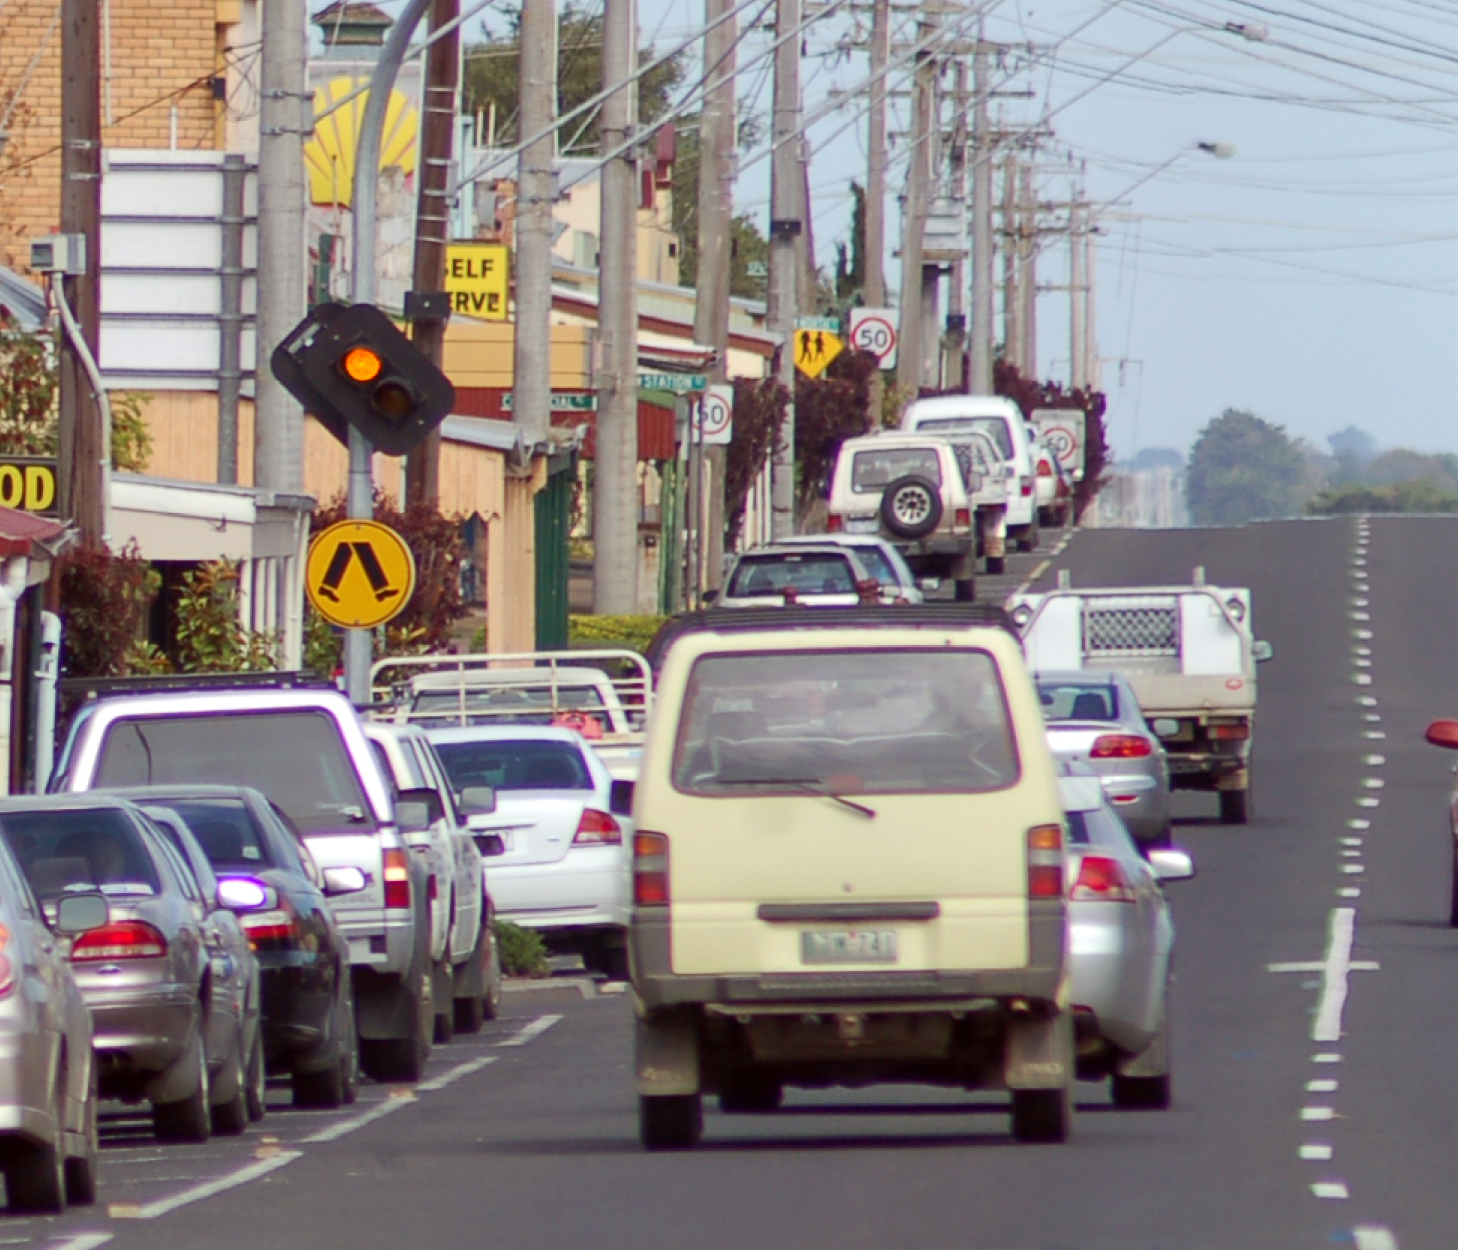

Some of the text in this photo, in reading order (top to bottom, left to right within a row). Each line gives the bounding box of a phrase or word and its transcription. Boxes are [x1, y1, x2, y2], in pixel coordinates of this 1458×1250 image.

[445, 258, 495, 278] ELF
[450, 291, 500, 313] RVE
[860, 328, 889, 349] 50
